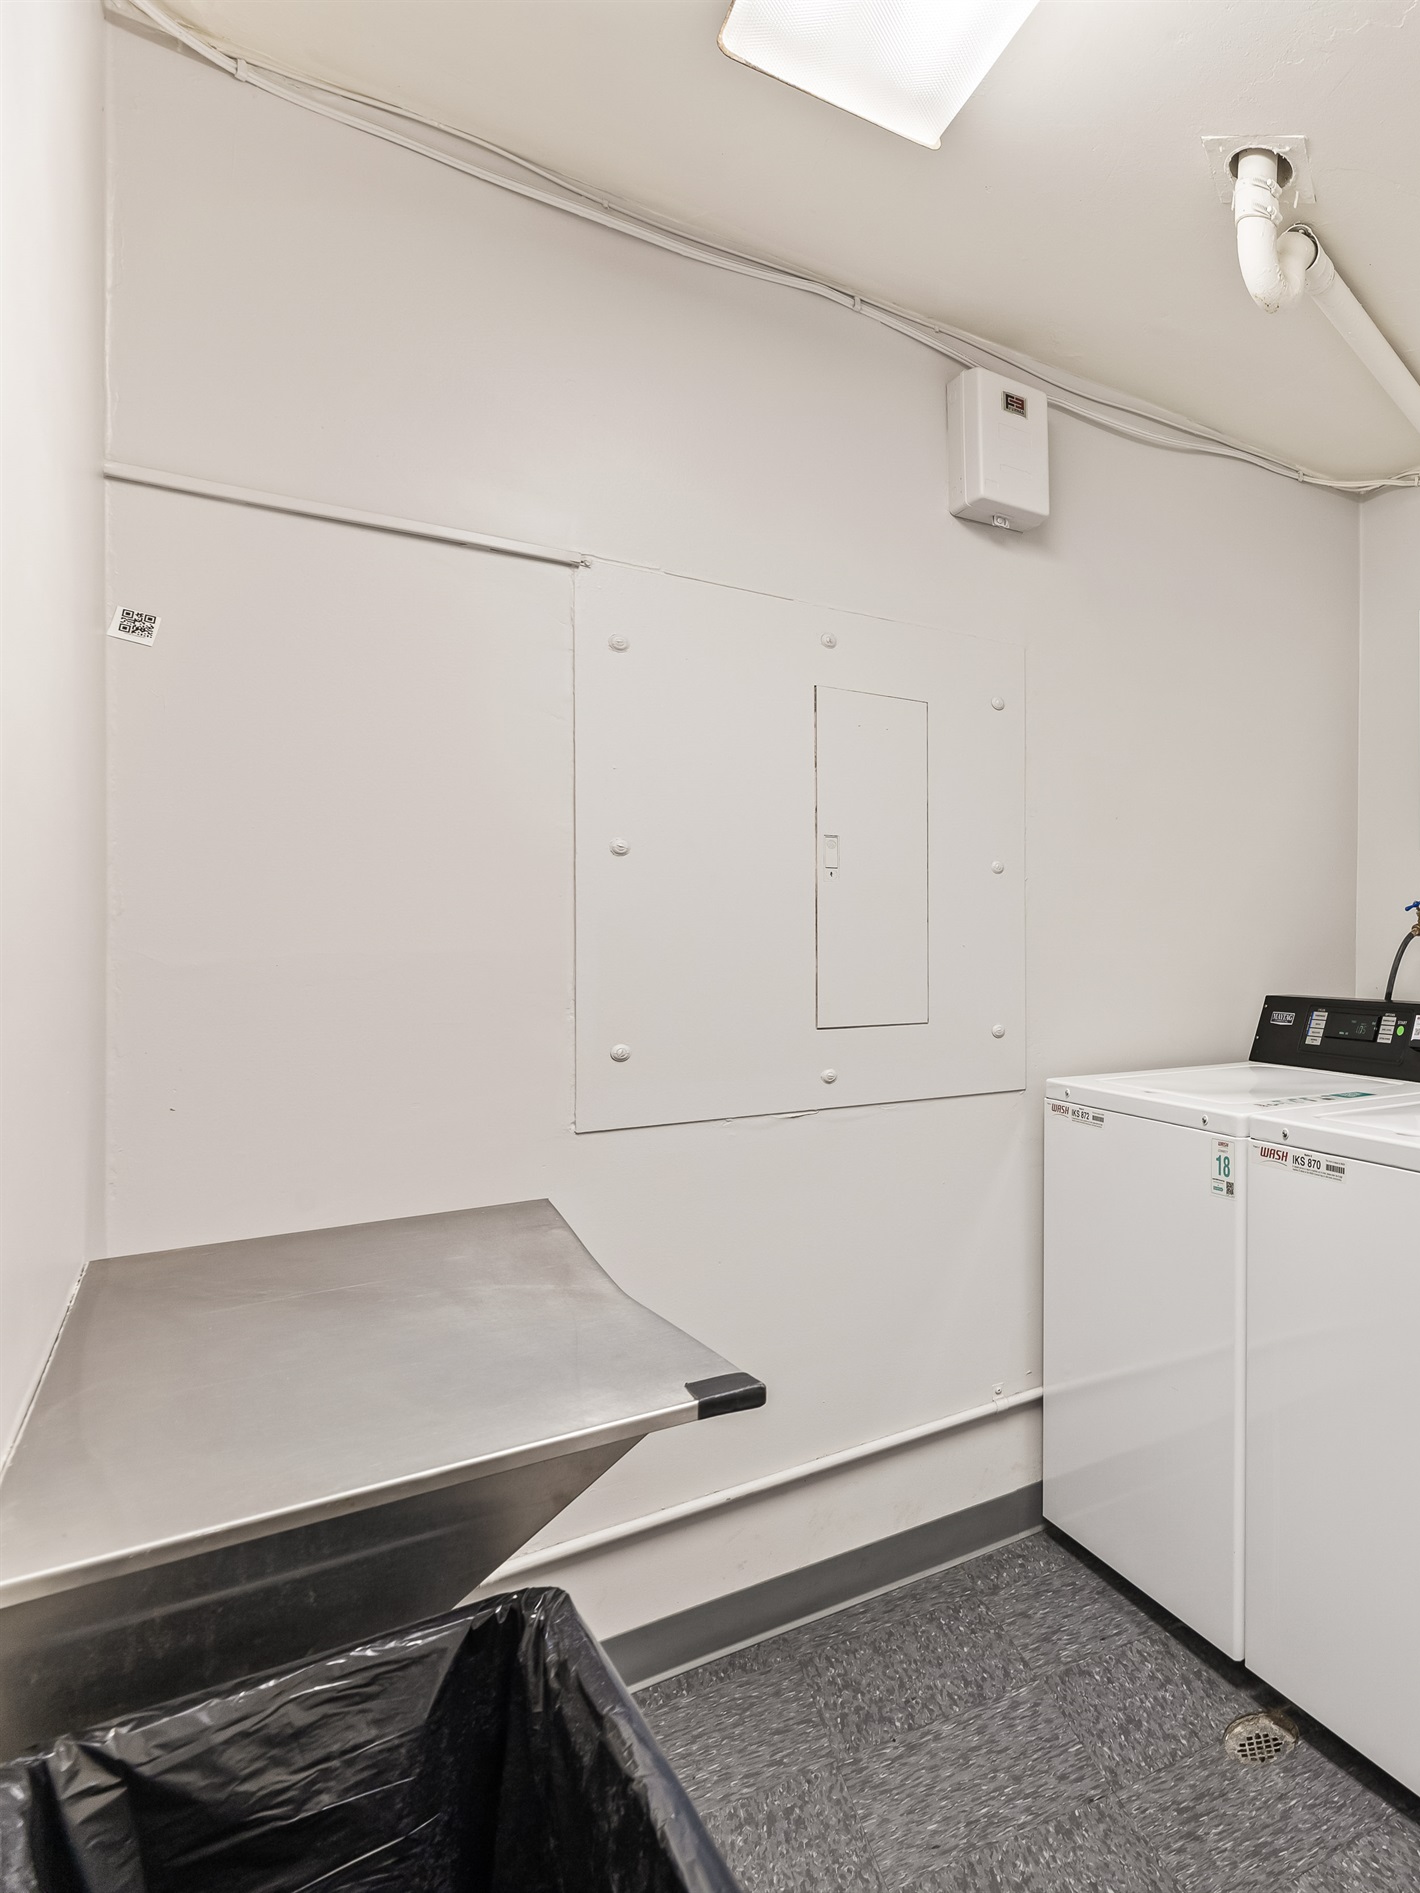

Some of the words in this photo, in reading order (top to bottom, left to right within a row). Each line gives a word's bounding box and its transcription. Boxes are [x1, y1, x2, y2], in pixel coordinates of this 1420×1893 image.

[1051, 1103, 1070, 1115] WASH
[1071, 1109, 1081, 1118] IKS
[1081, 1111, 1090, 1120] 872
[1260, 1146, 1288, 1162] WASH
[1216, 1154, 1231, 1178] 18
[1292, 1155, 1305, 1167] IKS
[1307, 1158, 1321, 1170] 870
